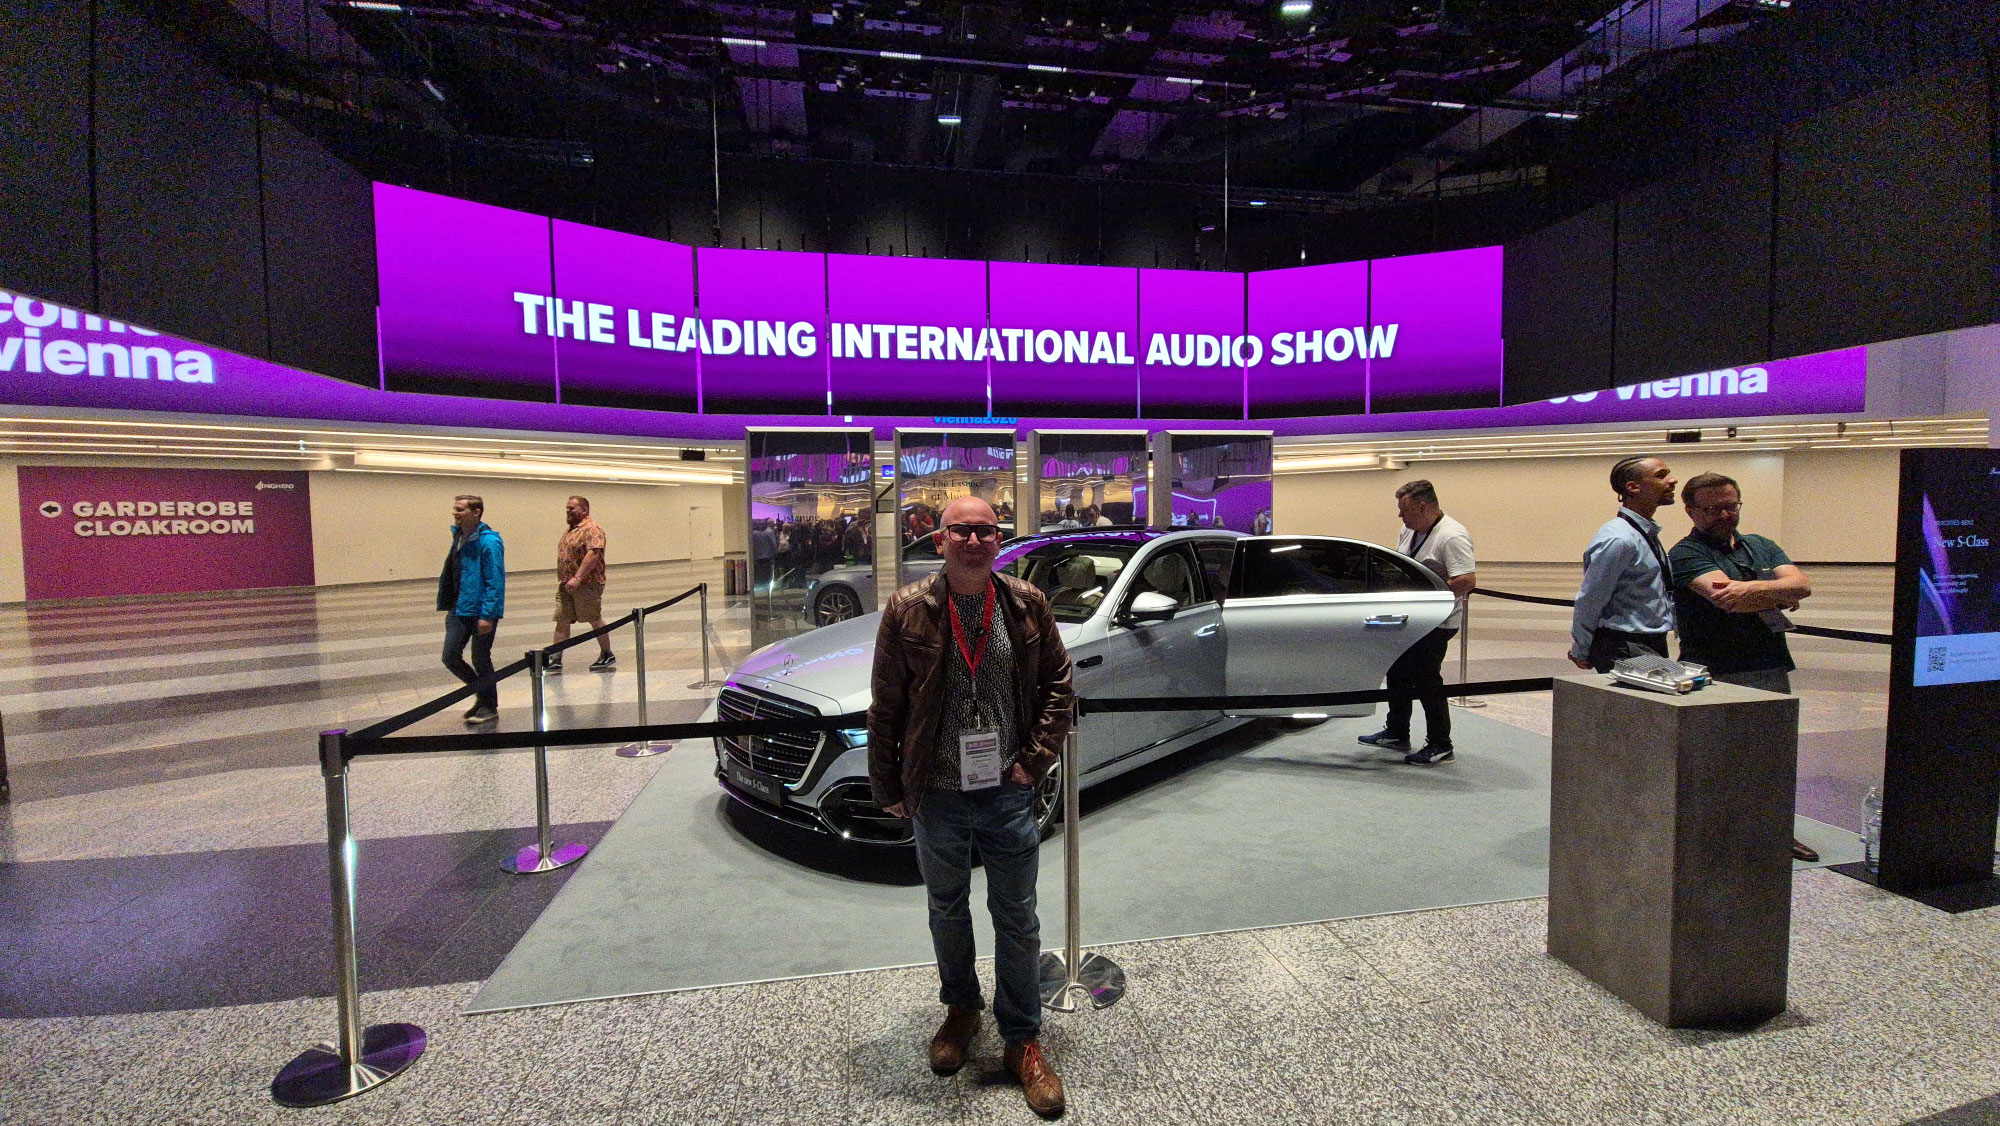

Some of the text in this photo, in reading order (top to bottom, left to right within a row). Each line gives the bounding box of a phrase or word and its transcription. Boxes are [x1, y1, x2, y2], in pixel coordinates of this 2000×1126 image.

[513, 291, 1399, 368] THE LEADING INTERNATIONAL AUDIO SHOW
[0, 327, 214, 384] vienna
[73, 501, 254, 517] GARDEROBE
[74, 519, 254, 537] CLOAKROOM
[1933, 535, 1989, 548] New S-Class
